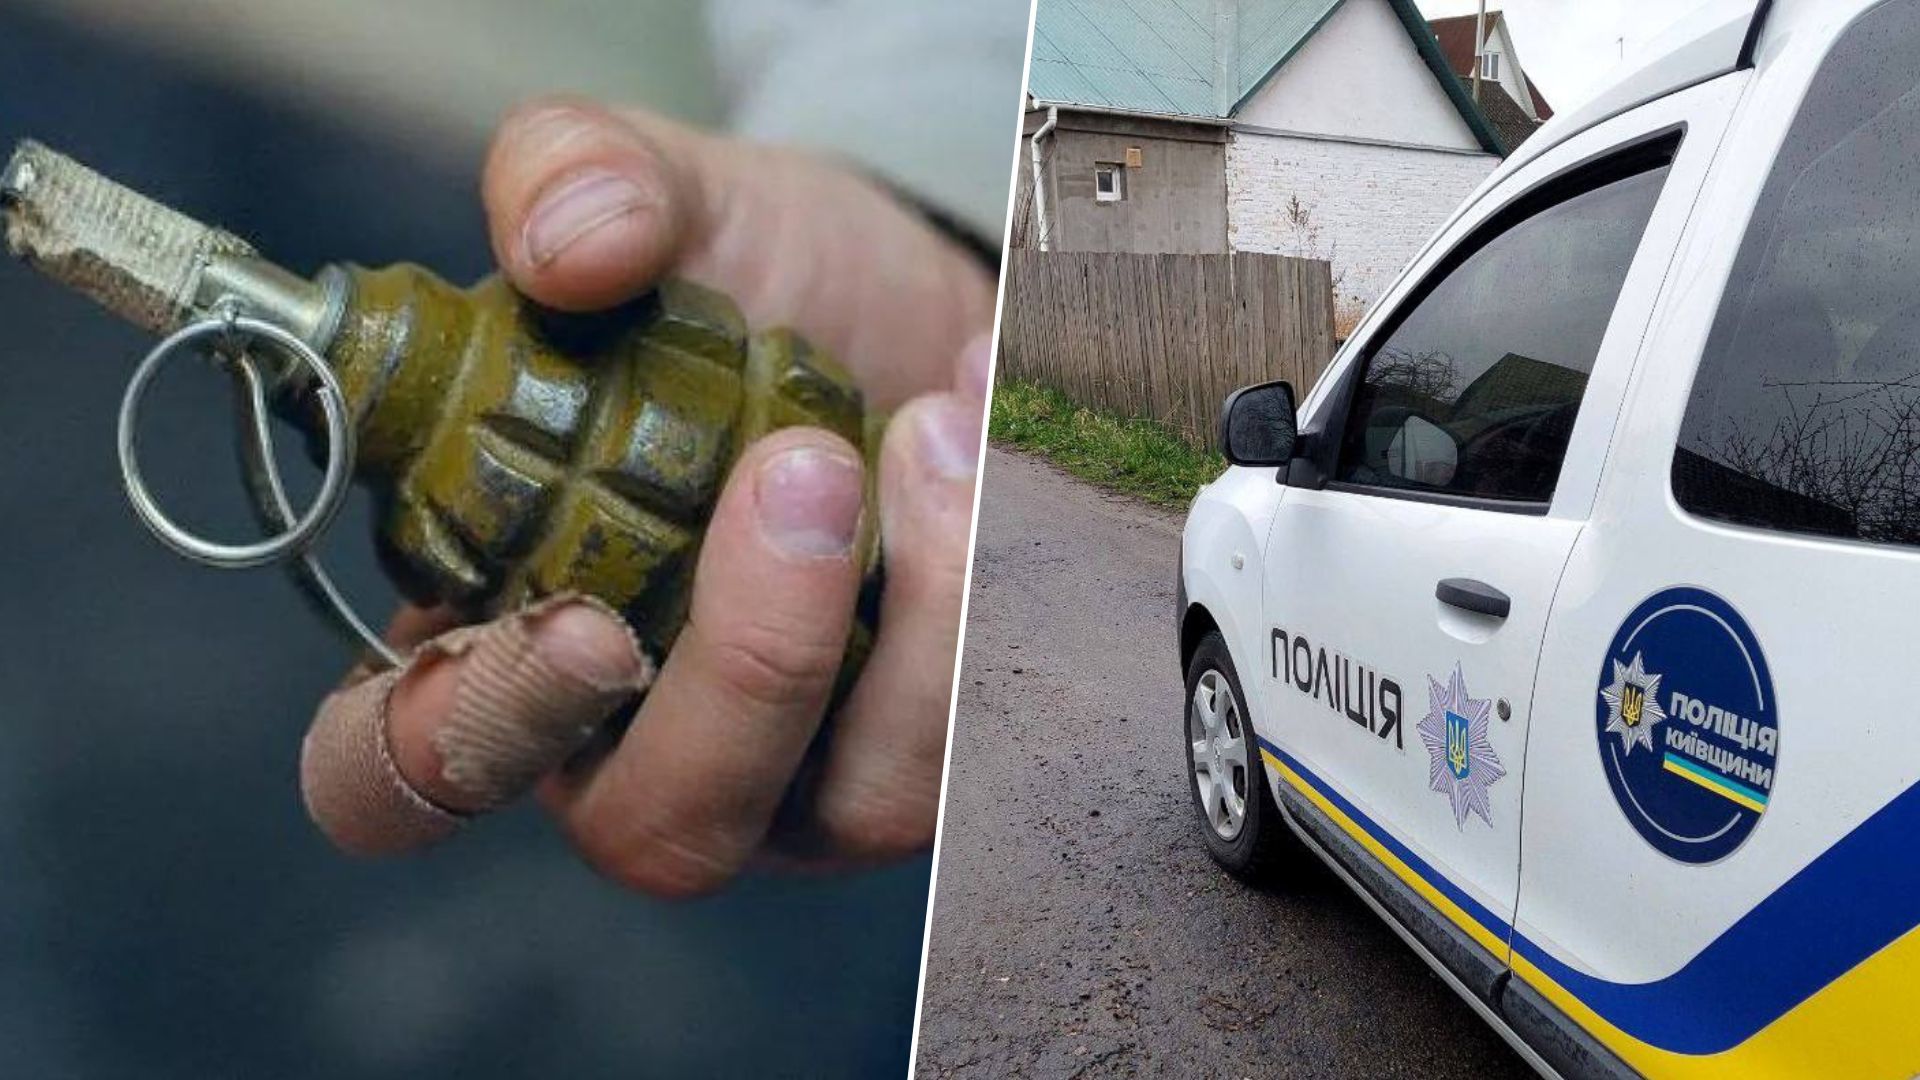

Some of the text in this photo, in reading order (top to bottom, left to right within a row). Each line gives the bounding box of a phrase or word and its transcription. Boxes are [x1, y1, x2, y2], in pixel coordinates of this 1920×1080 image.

[1271, 627, 1403, 750] ПОЛІЦІЯ
[1669, 692, 1778, 757] ПОЛІЦІЯ
[1665, 727, 1772, 789] КИЇВЩИНИ
